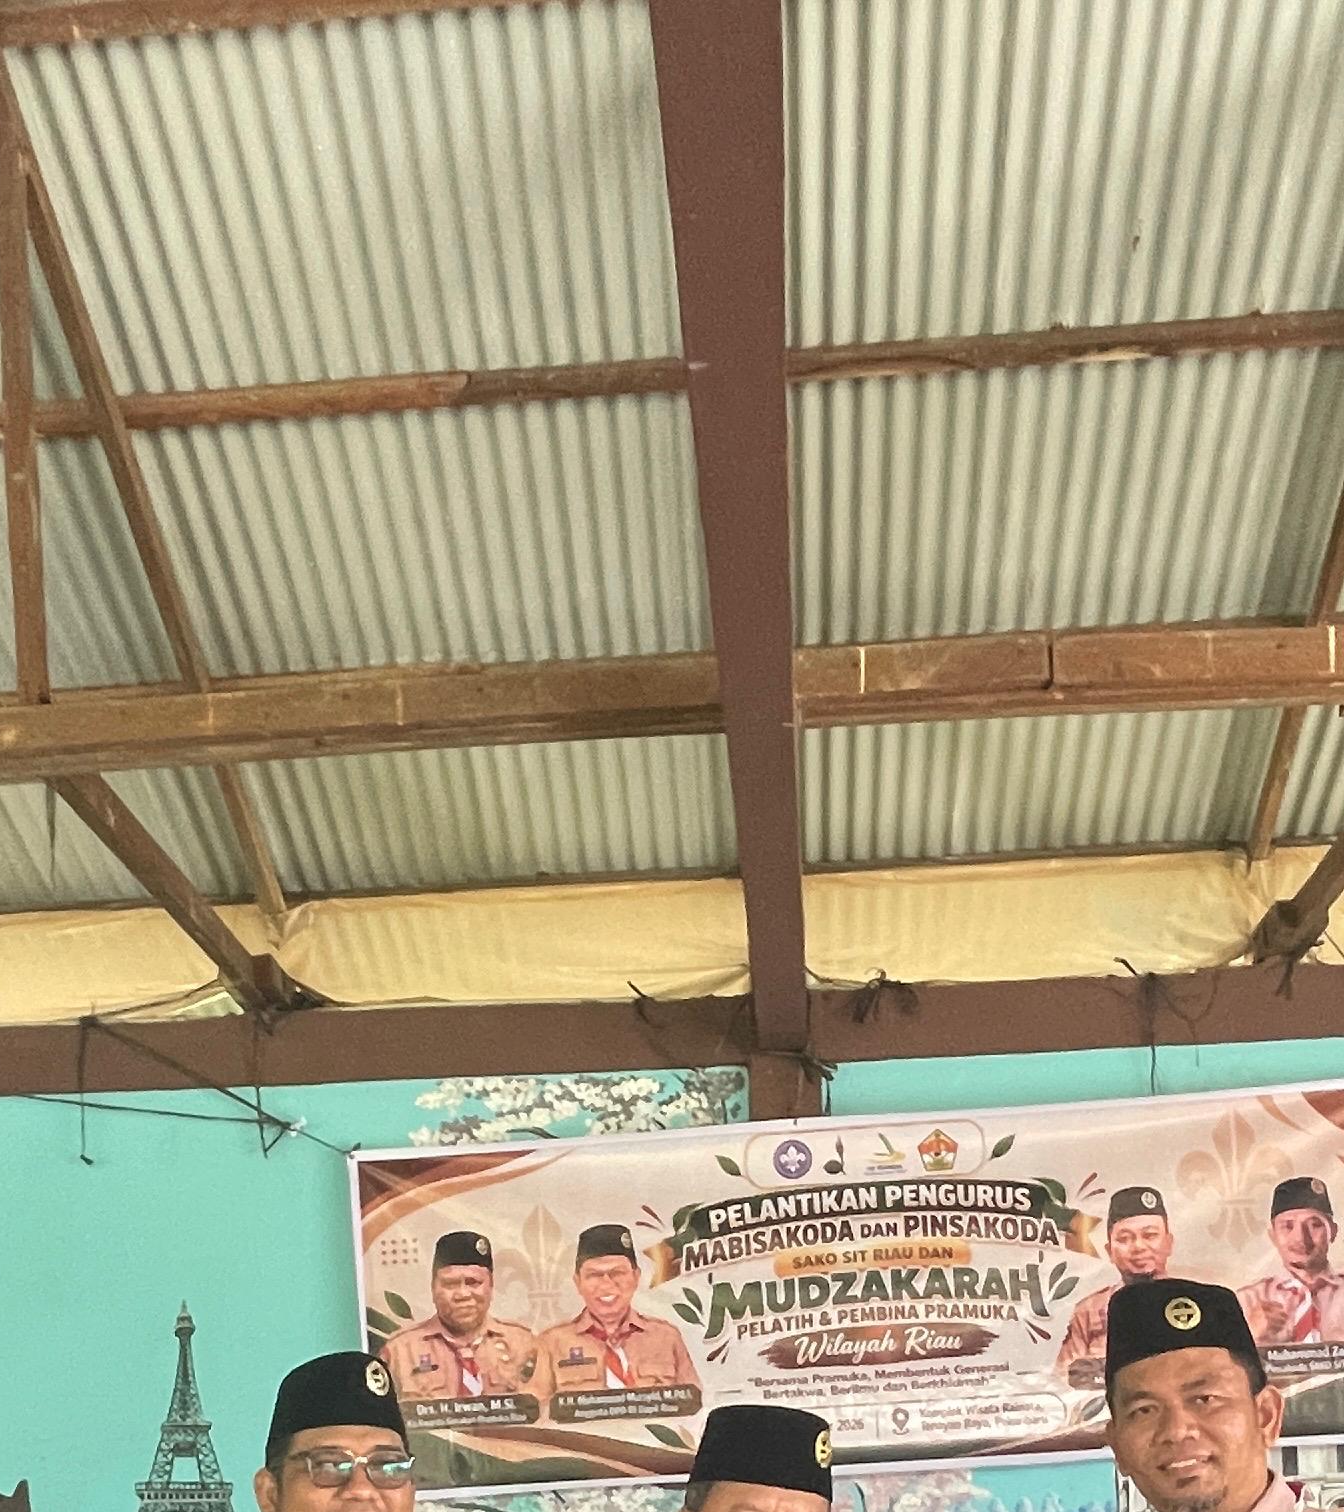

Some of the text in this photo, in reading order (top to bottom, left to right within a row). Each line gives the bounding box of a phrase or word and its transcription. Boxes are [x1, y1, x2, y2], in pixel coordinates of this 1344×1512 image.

[708, 1183, 1032, 1232] PELANTIKAN PENGURUS
[684, 1215, 1060, 1271] MABISAKODA DAN PINSAKODA
[792, 1247, 954, 1269] SAKO SIT RIAU DAN
[704, 1263, 1050, 1339] MUDZAKARAH
[737, 1304, 1019, 1340] PELATIH & PEMBINA PRAMUKA
[794, 1326, 963, 1364] Wilayah Riau
